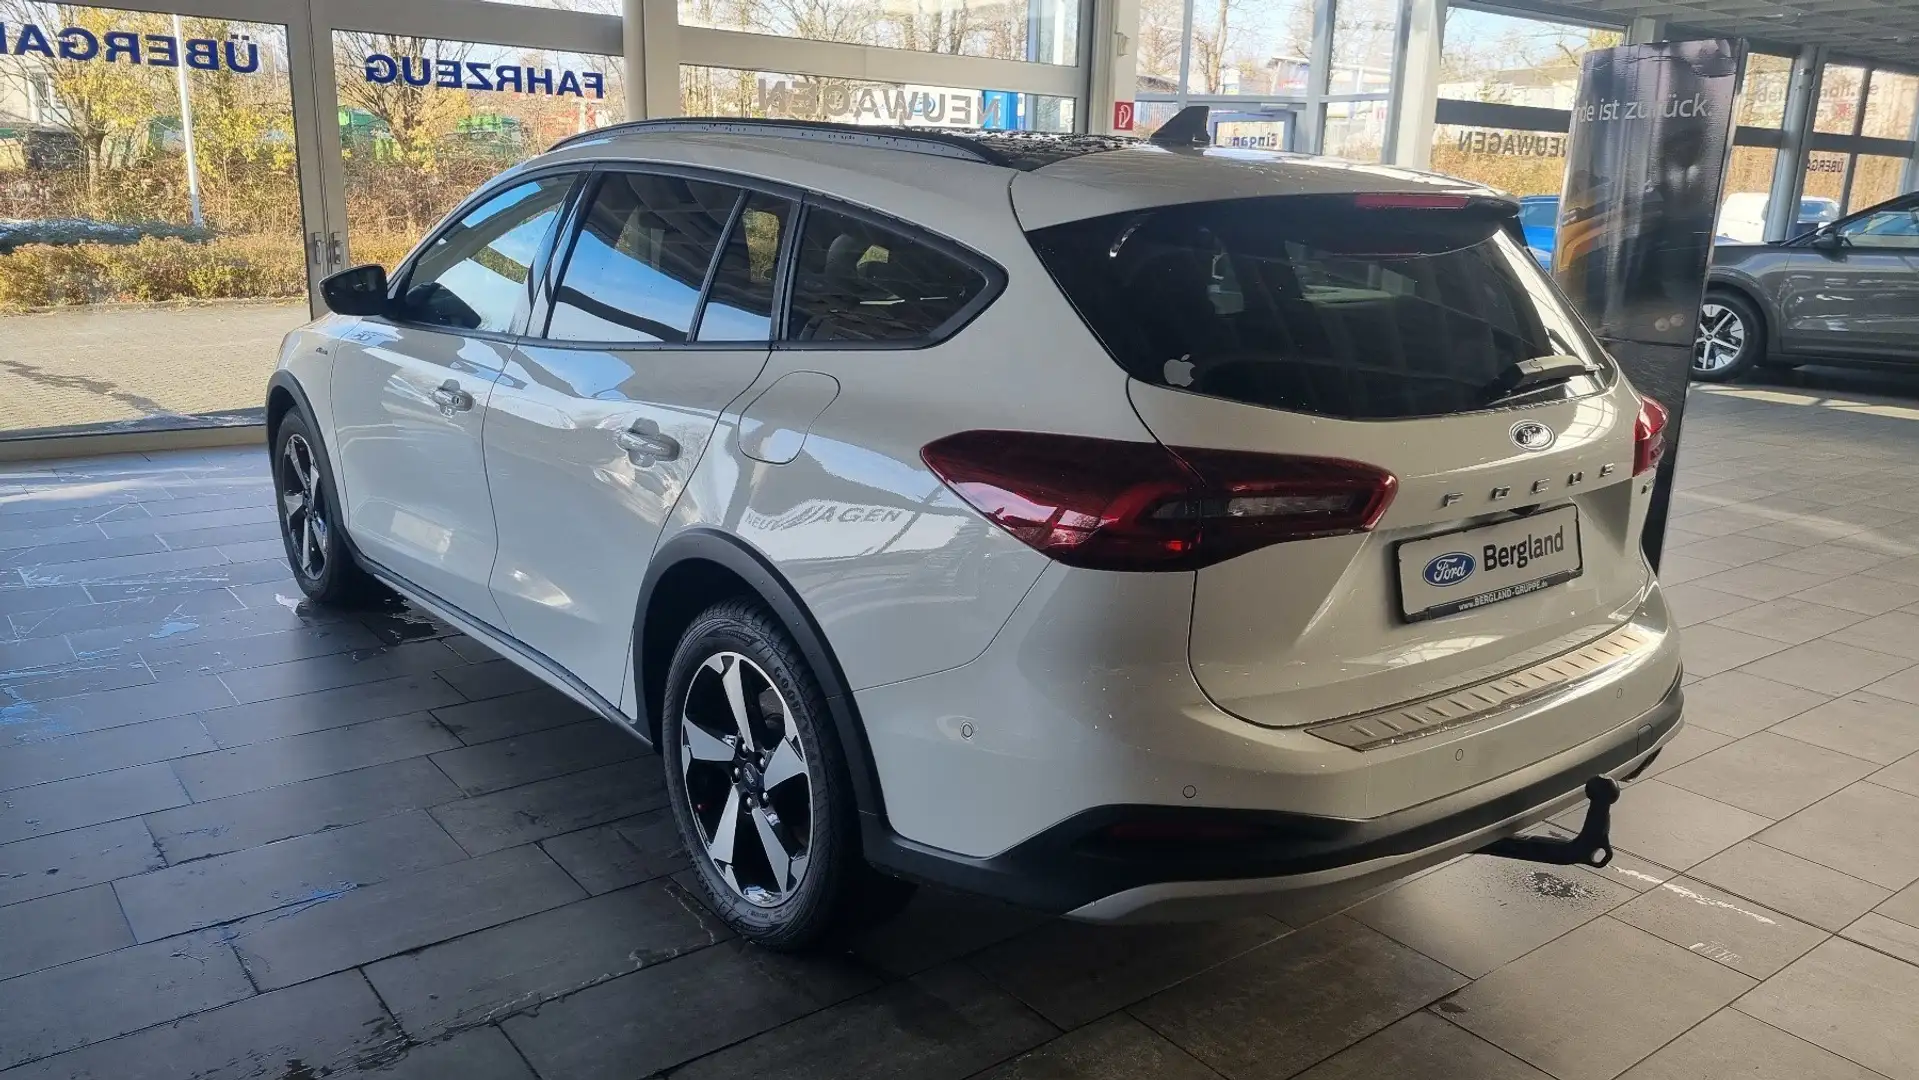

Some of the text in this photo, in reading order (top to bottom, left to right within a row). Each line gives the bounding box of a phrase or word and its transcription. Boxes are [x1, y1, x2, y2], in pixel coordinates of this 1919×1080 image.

[1599, 98, 1619, 120] ist
[1443, 464, 1615, 506] FOCUS
[1483, 526, 1564, 571] Bergland
